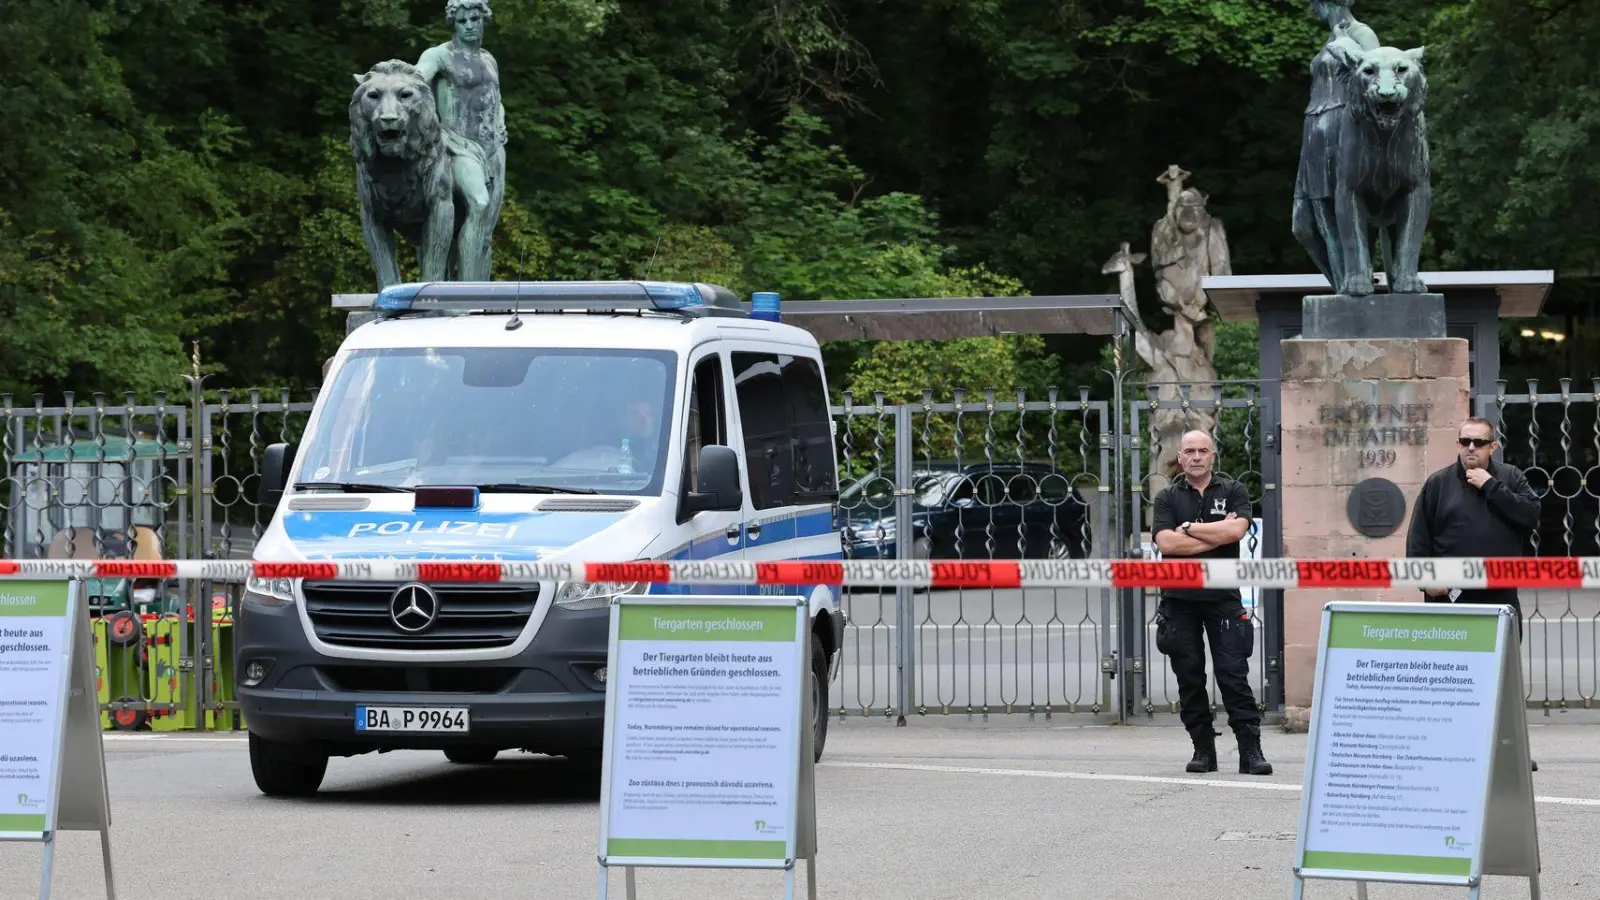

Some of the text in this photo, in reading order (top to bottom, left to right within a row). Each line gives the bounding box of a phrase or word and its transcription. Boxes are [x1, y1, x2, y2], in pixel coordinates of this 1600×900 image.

[1358, 449, 1397, 469] 1939
[348, 520, 520, 538] POLIZEI
[653, 618, 763, 632] Tiergarten geschlossen
[4, 628, 27, 638] heute
[29, 630, 43, 638] aus
[1362, 625, 1468, 642] Tiergarten geschlossen
[0, 642, 51, 654] geschlossen.
[643, 652, 773, 664] Der Tiergarten bleibt heute aus
[1356, 660, 1468, 671] Der Tiergarten bleibt heute aus
[633, 667, 781, 679] betrieblichen Gründen geschlossen.
[1346, 672, 1475, 686] betrieblichen Gründen geschlossen.
[367, 709, 465, 729] BA P 9964
[730, 725, 760, 733] operational
[628, 779, 641, 787] Zoo
[665, 779, 681, 787] dnes
